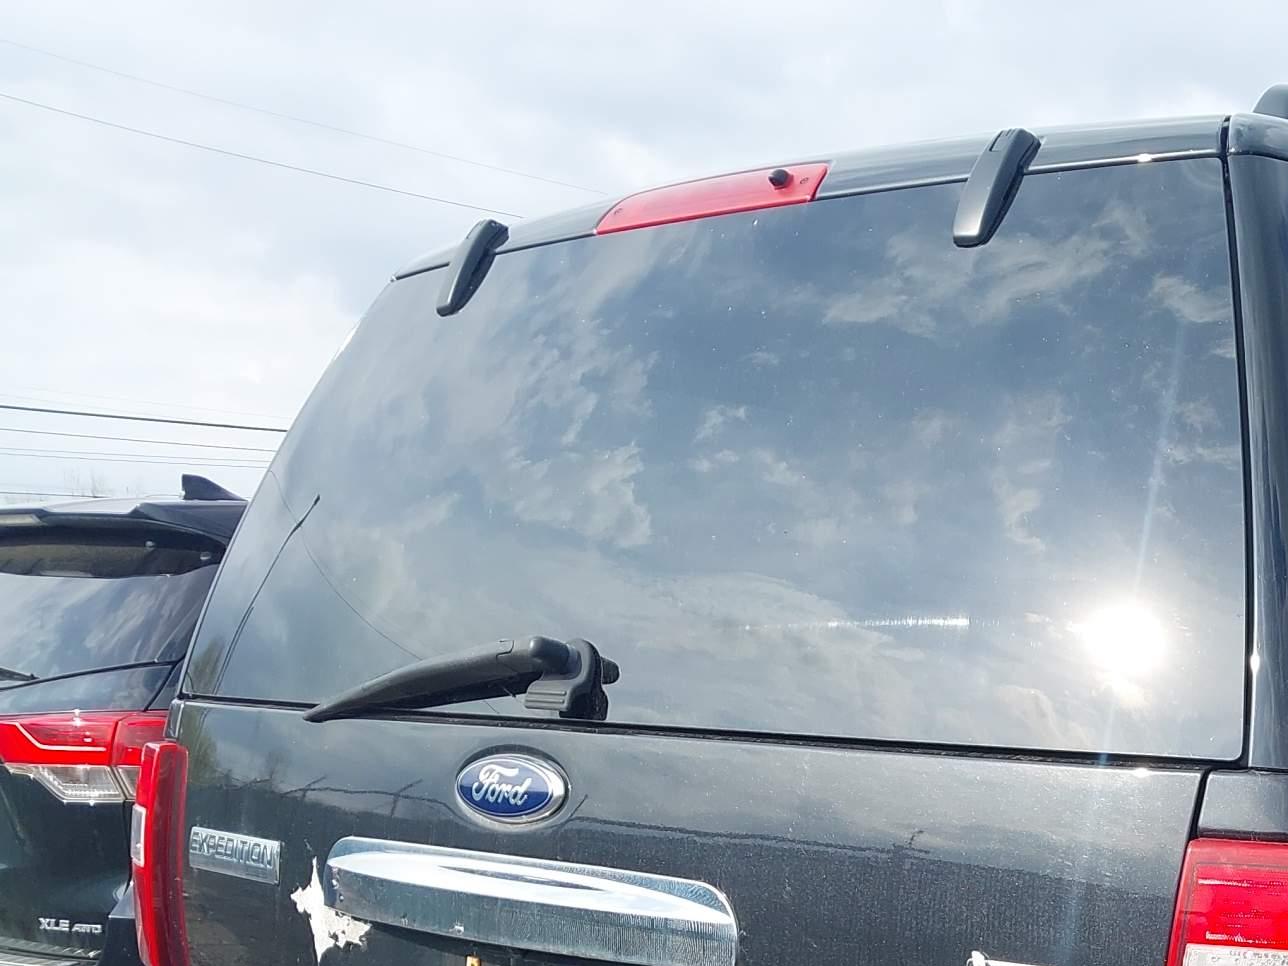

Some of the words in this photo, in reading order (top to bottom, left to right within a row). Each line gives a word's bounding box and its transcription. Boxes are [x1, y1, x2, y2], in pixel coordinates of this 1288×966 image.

[471, 764, 533, 807] Ford
[190, 831, 275, 868] EXPEDITION
[38, 917, 70, 931] XLE
